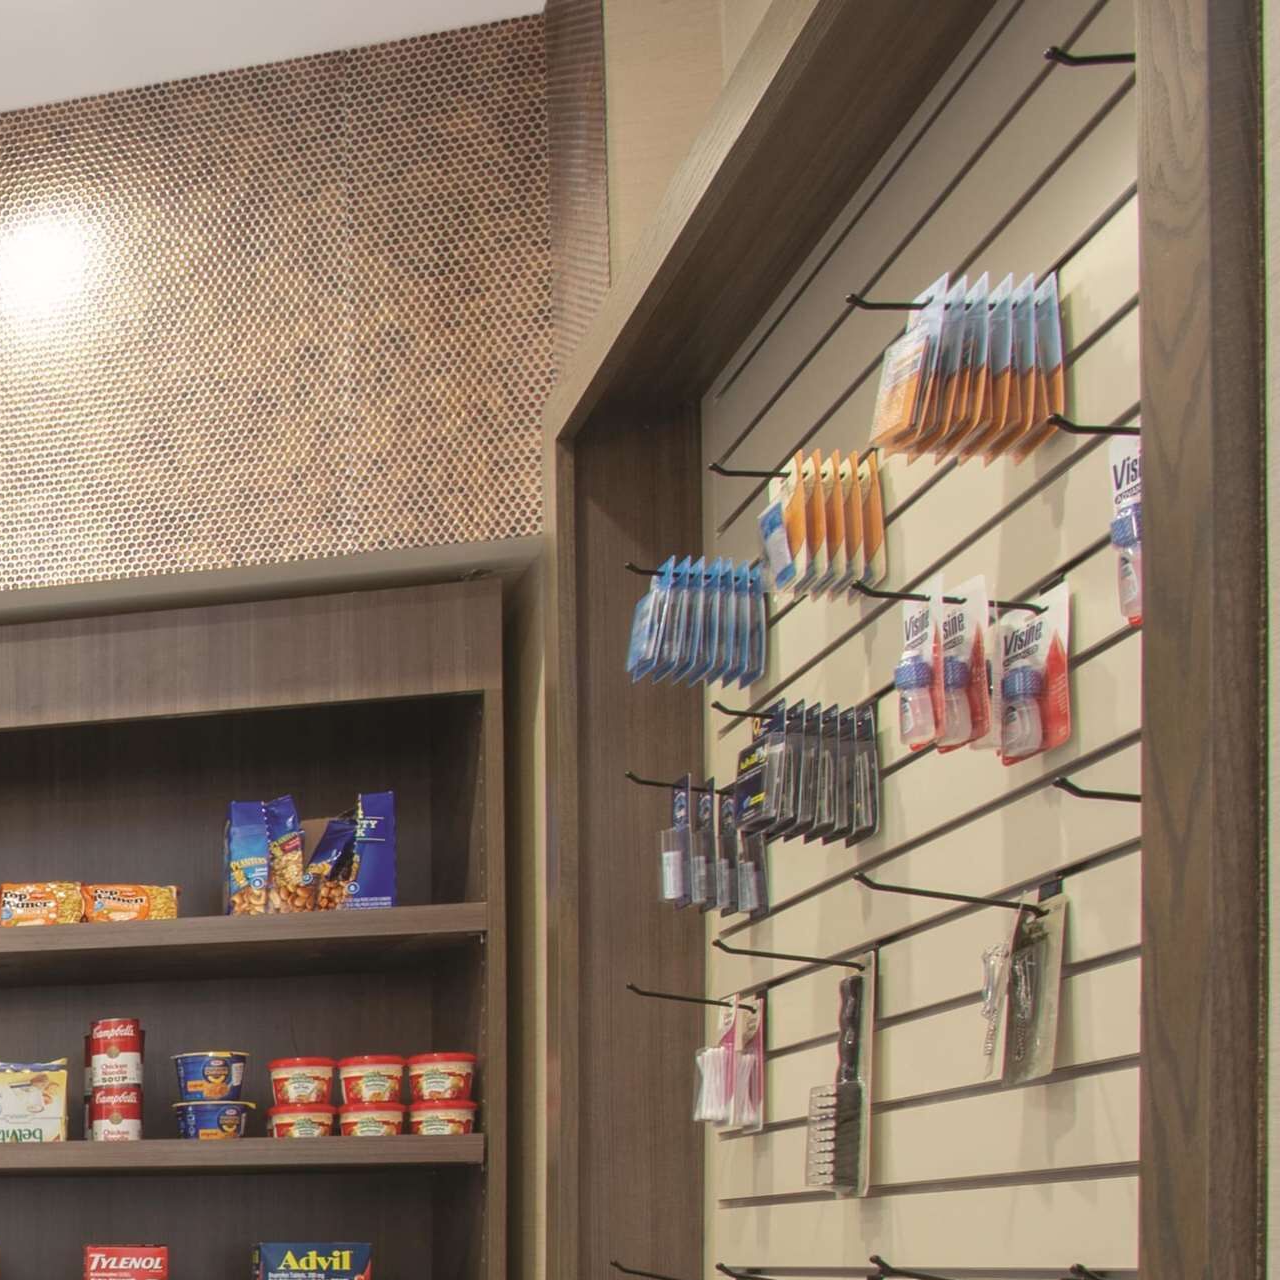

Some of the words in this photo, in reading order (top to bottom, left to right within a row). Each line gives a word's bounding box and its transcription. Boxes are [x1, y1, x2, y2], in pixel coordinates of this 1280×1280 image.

[1113, 456, 1141, 491] Vis
[943, 611, 965, 640] sine
[1004, 620, 1043, 655] Visine
[89, 1253, 164, 1271] TYLENOL
[277, 1250, 353, 1271] Advil
